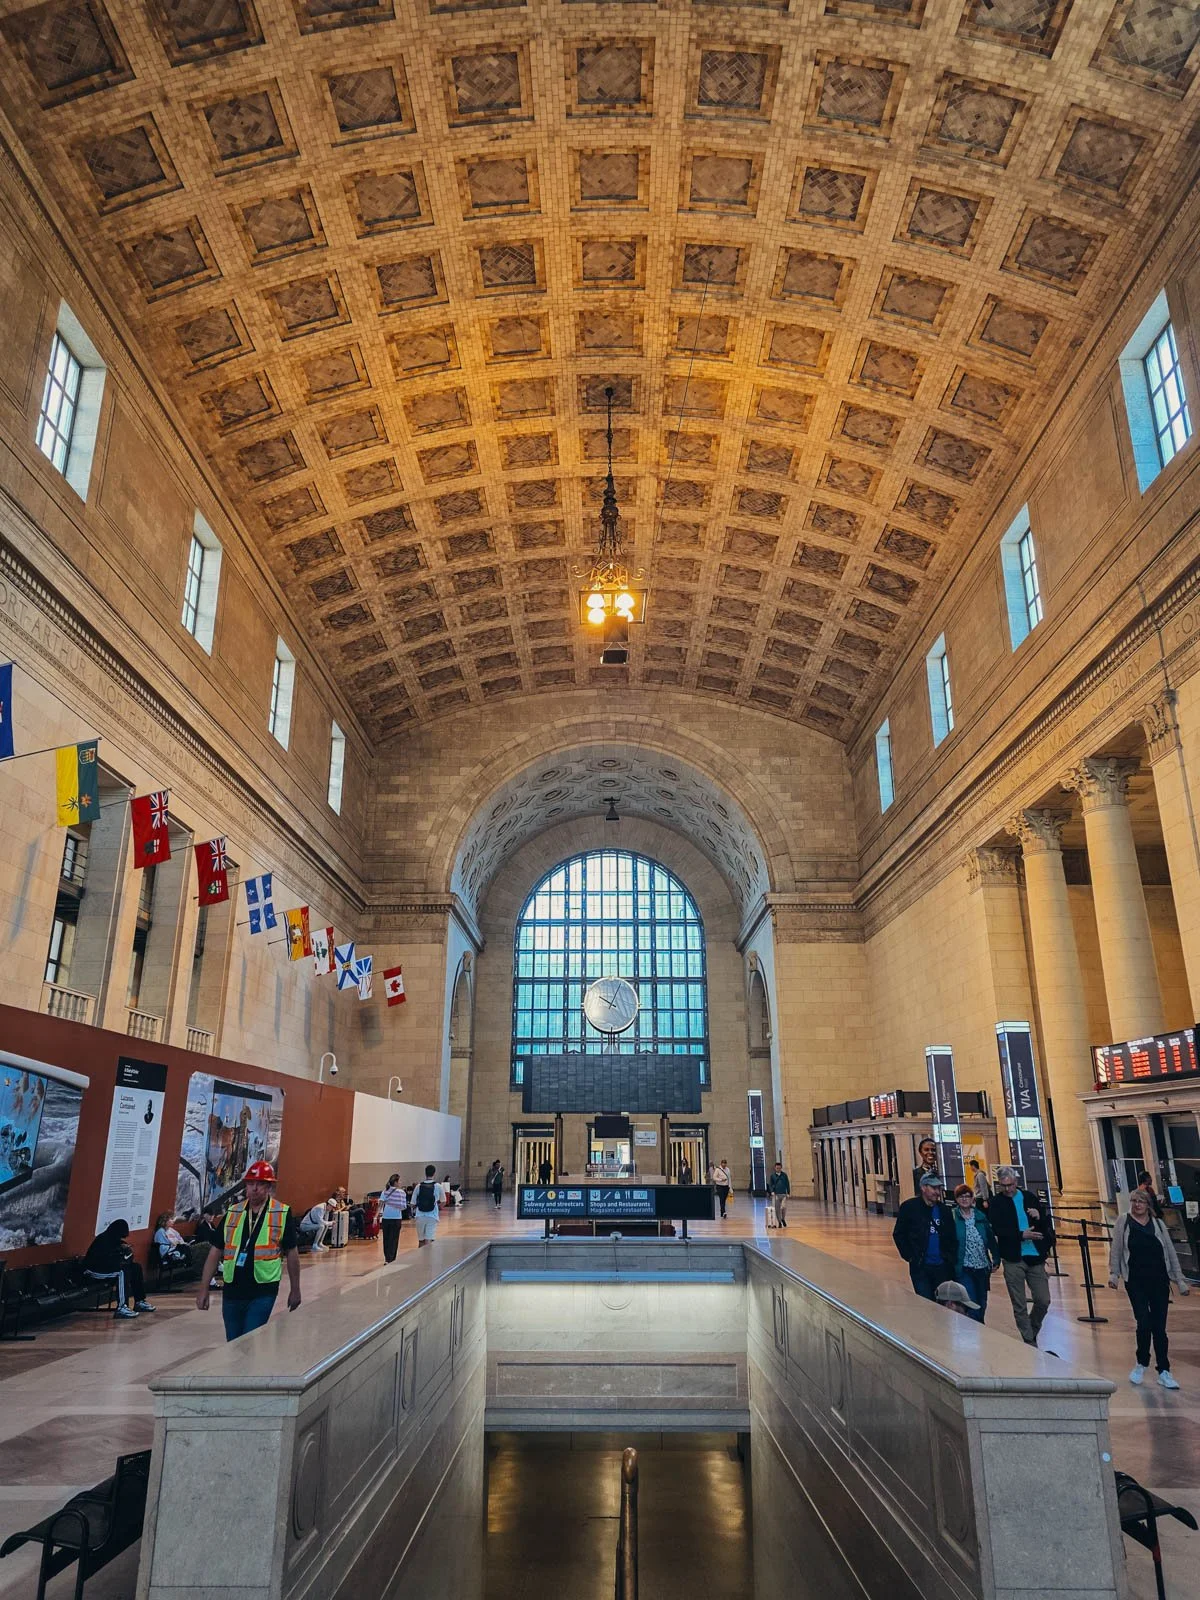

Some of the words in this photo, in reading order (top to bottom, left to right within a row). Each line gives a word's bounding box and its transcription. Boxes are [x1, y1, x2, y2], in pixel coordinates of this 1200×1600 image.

[1090, 656, 1142, 716] SUDBURY
[1020, 1089, 1031, 1109] VIA
[943, 1101, 952, 1118] VIA
